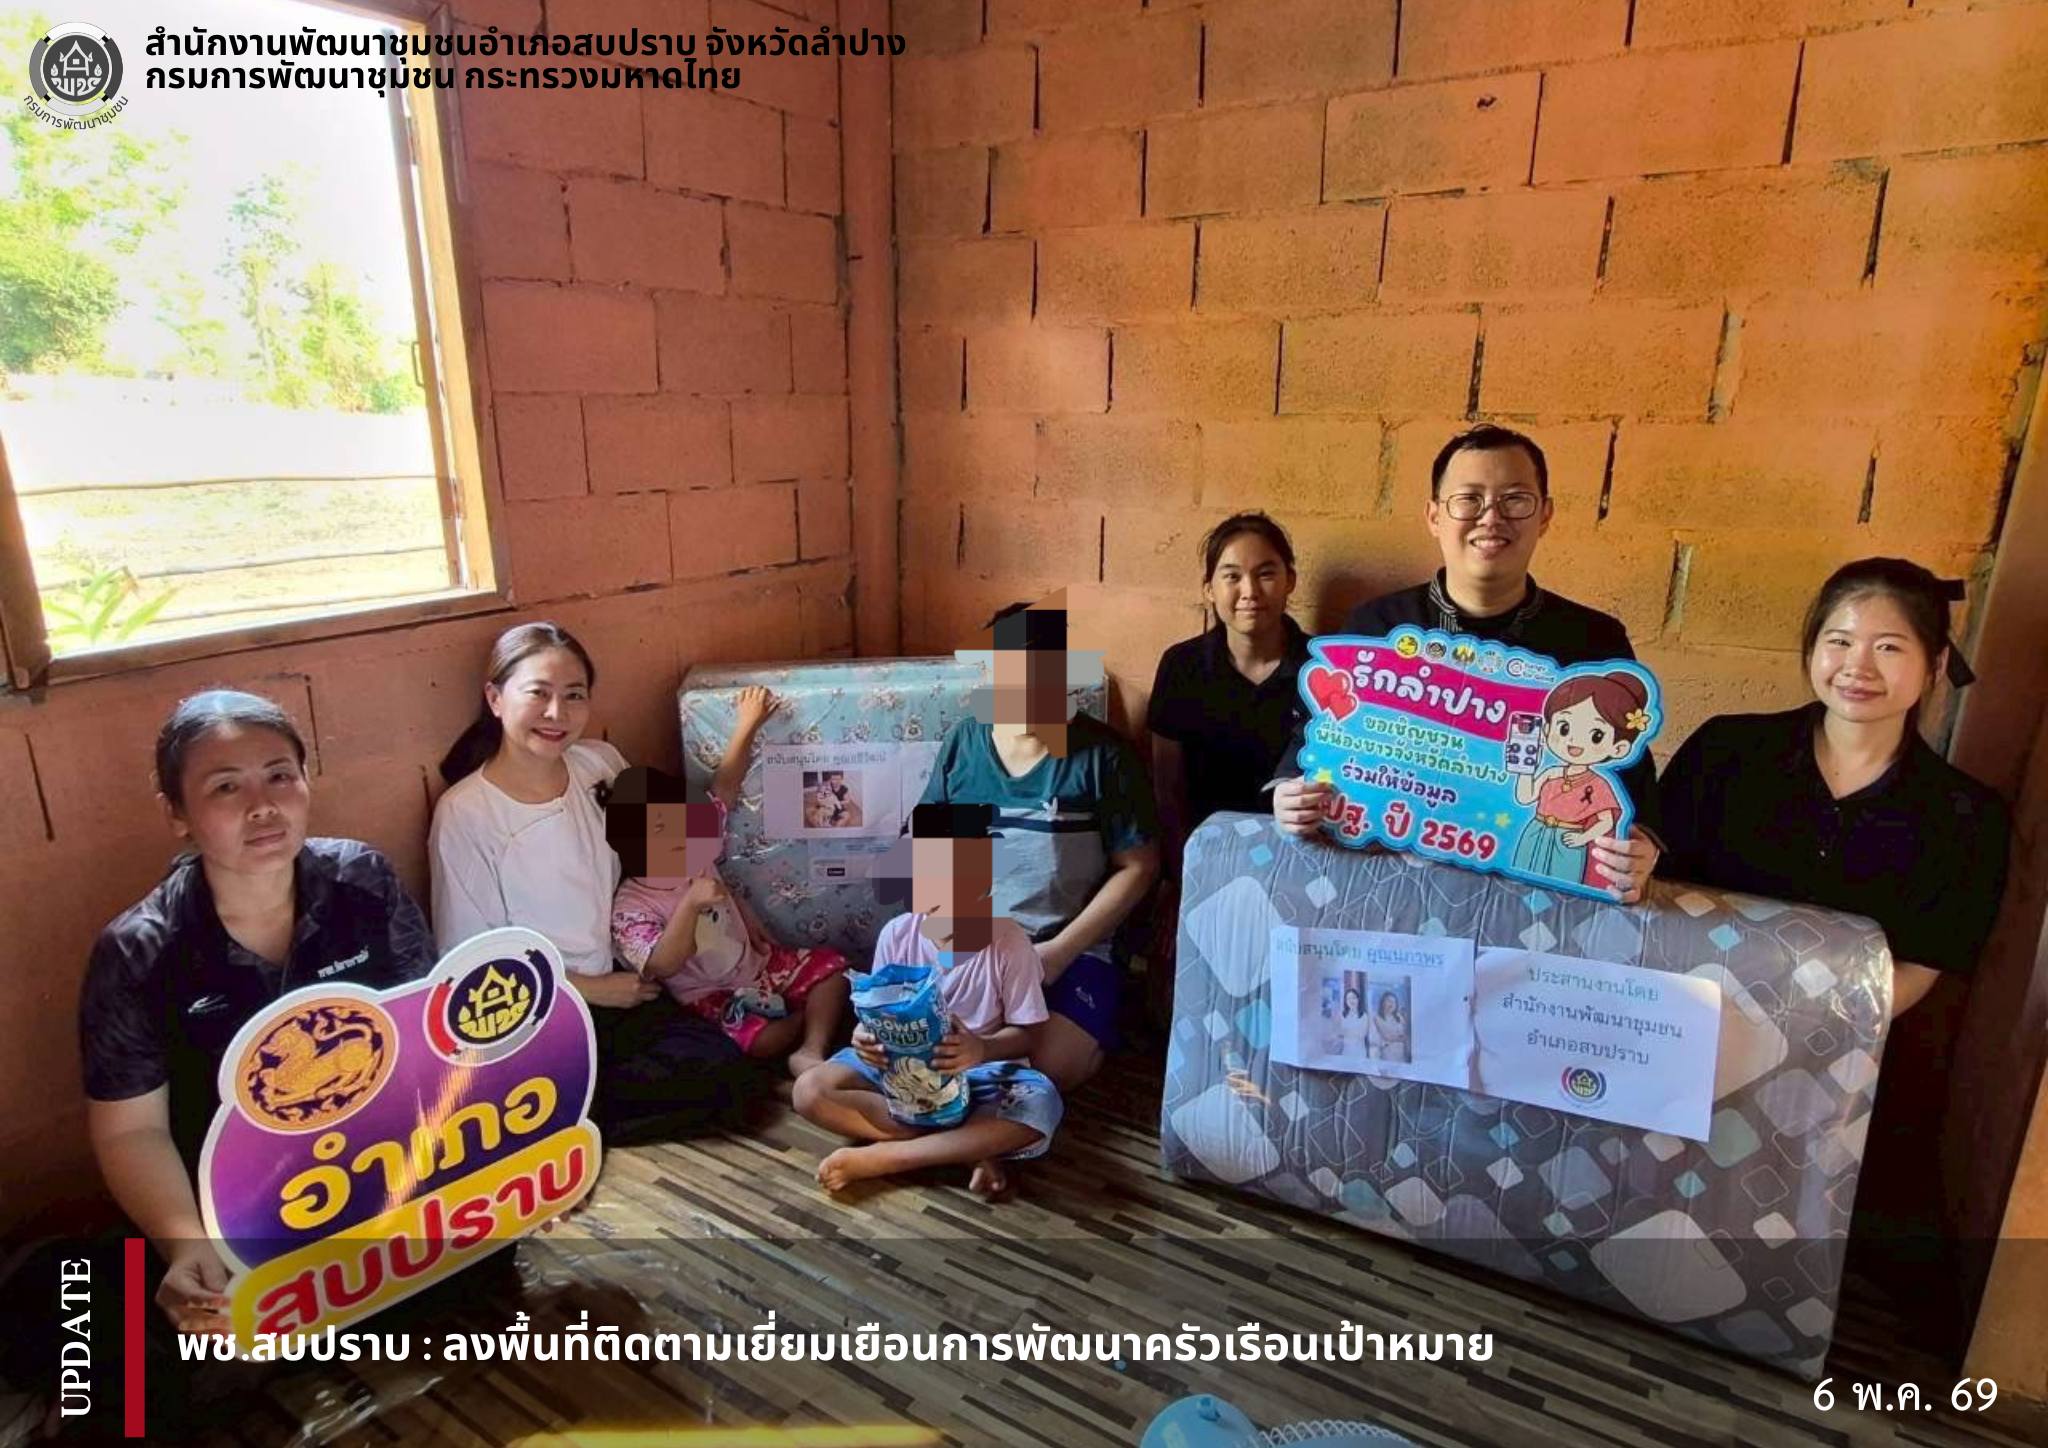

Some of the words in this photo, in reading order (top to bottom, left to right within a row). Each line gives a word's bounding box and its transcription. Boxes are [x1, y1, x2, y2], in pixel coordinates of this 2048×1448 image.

[1352, 650, 1507, 724] รักลำปาง
[1315, 722, 1509, 783] พี่น้องชาวจังหวัดลำปาง
[1364, 716, 1465, 750] ขอเชิญชวน
[1342, 757, 1457, 808] ร่วมให้ข้อมูล
[1385, 801, 1411, 838] ปี
[1421, 820, 1496, 860] 2569
[1528, 966, 1659, 1002] ประสานงานโดย
[1501, 992, 1683, 1038] สำนักงานพัฒนาชุมชน
[1527, 1028, 1649, 1065] อำเภอสบปราบ
[279, 1076, 558, 1230] อำเภอ
[255, 1145, 585, 1336] สบปราบ
